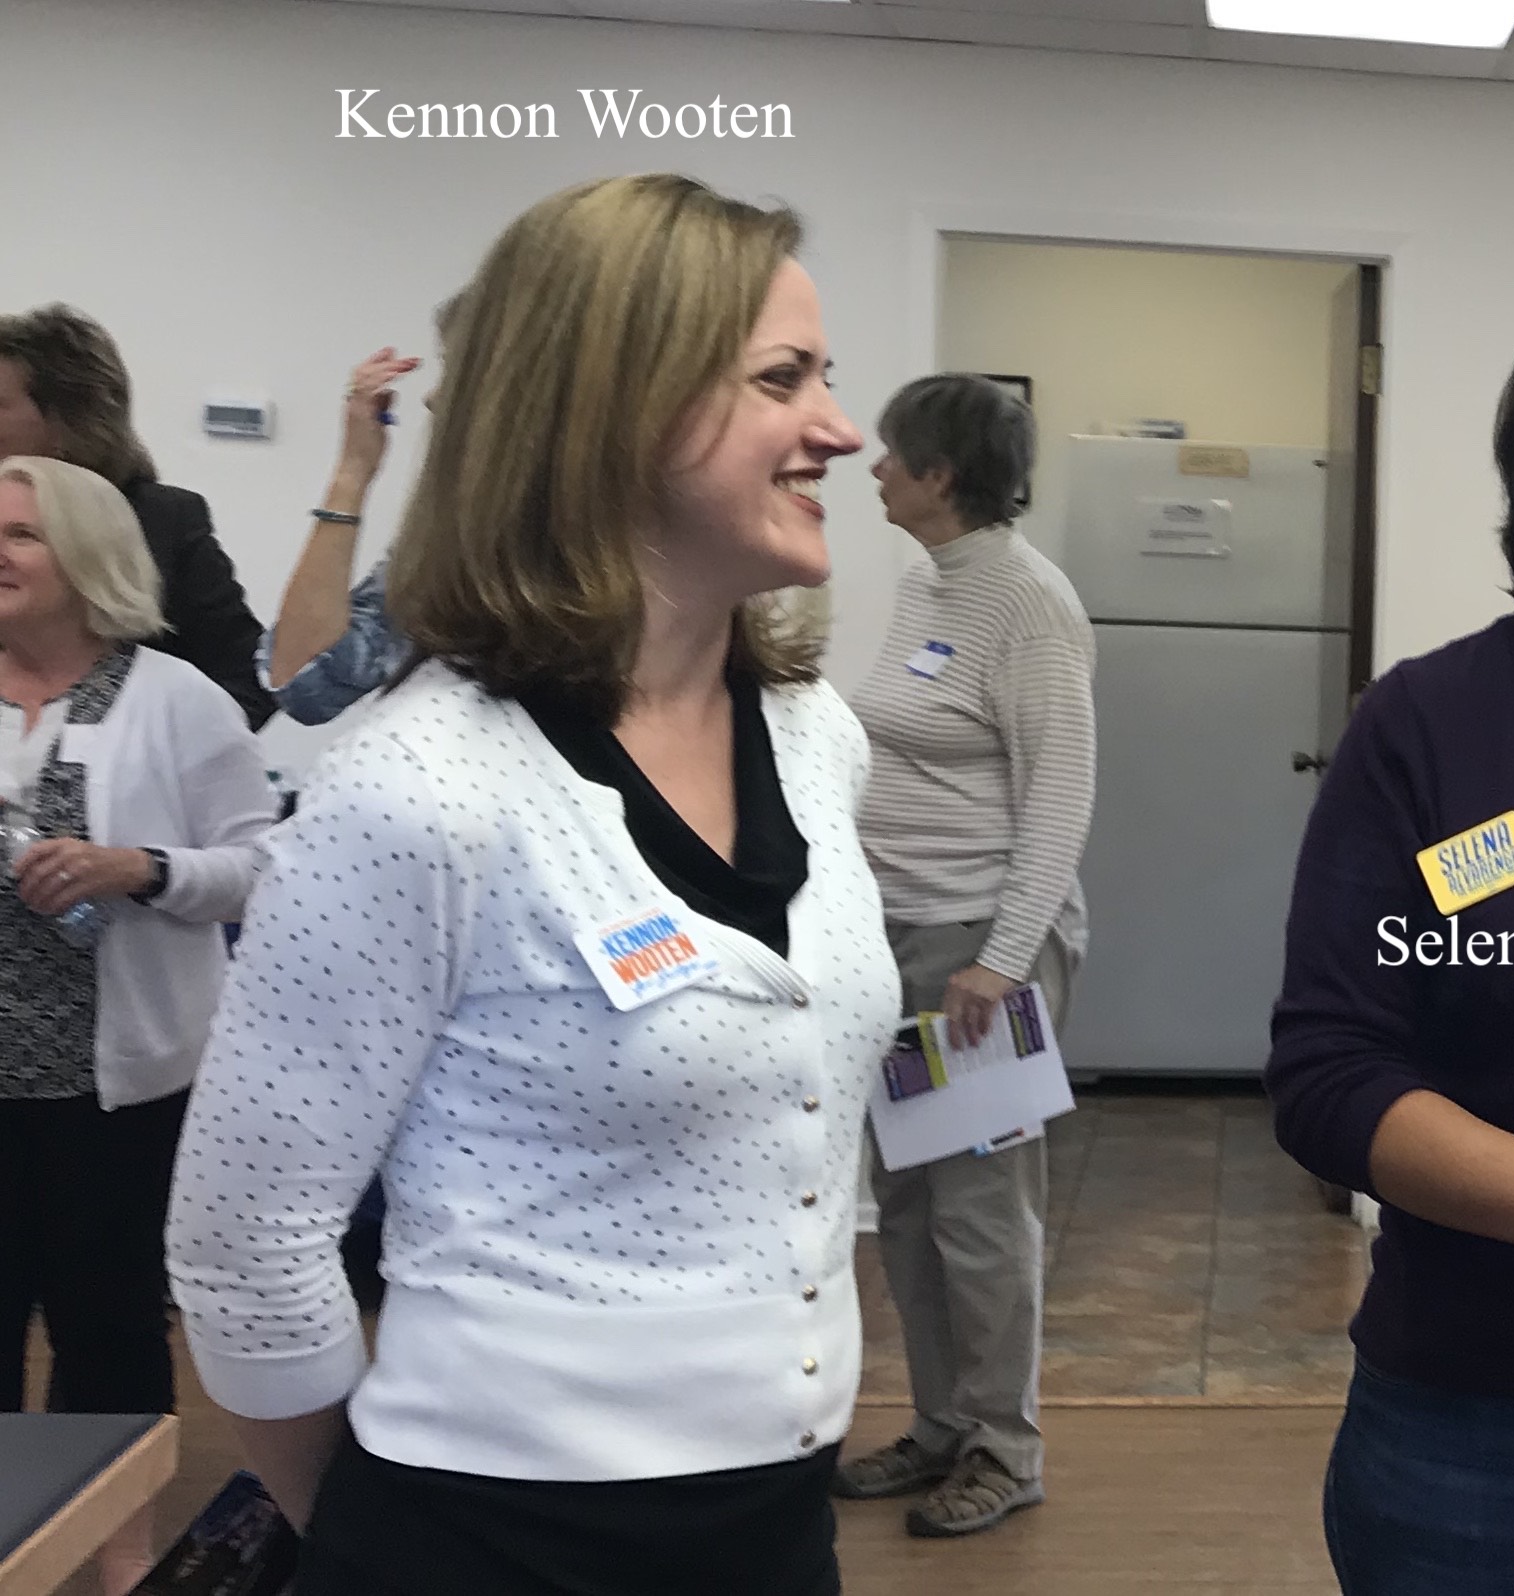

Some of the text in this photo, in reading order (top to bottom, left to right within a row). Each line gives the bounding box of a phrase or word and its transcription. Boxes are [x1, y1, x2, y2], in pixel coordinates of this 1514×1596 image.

[1437, 819, 1513, 876] SELENA
[601, 912, 678, 961] KENNON
[608, 931, 699, 985] WOOTEN
